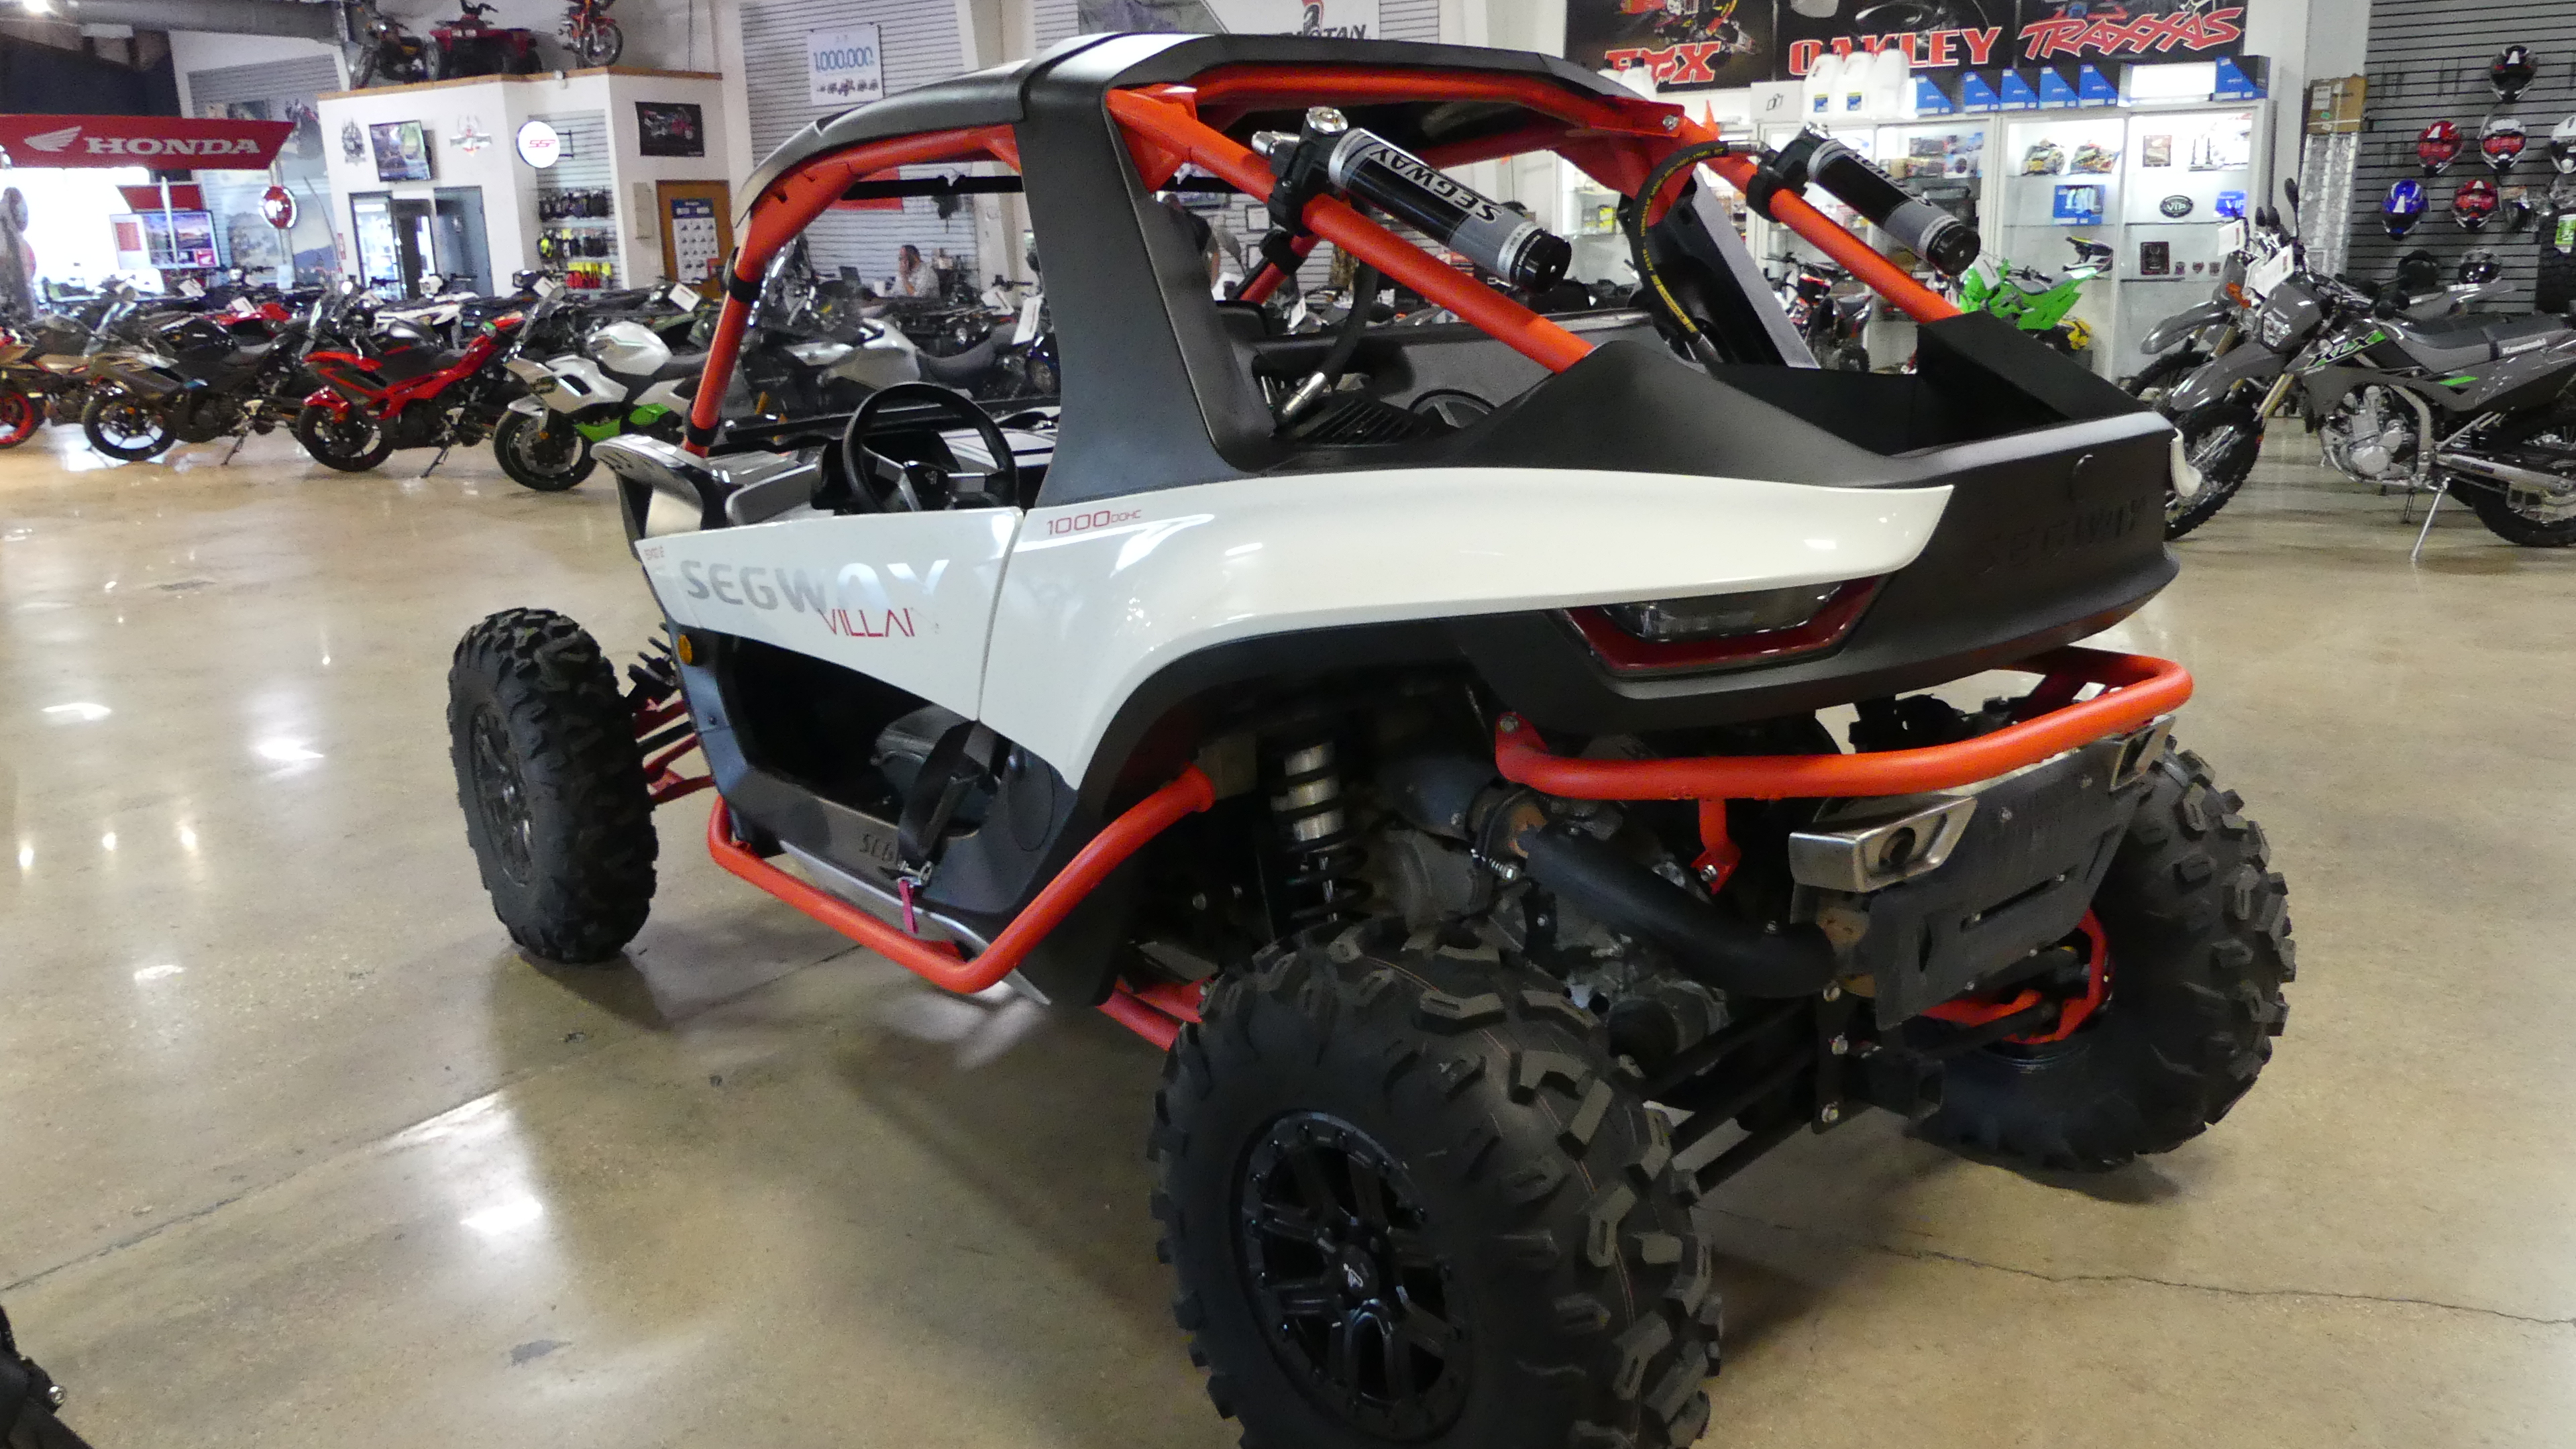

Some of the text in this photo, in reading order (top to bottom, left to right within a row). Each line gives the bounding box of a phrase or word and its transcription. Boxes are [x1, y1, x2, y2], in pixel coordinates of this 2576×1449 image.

[2017, 7, 2243, 60] TRAXXAS
[1605, 41, 1721, 87] FOX
[83, 136, 261, 155] HONDA
[1369, 146, 1505, 224] SEGWAY
[2166, 202, 2187, 211] VIP
[1047, 510, 1142, 535] 1000 DOHC
[680, 558, 951, 614] SEGWAY
[818, 600, 931, 638] VILLAI
